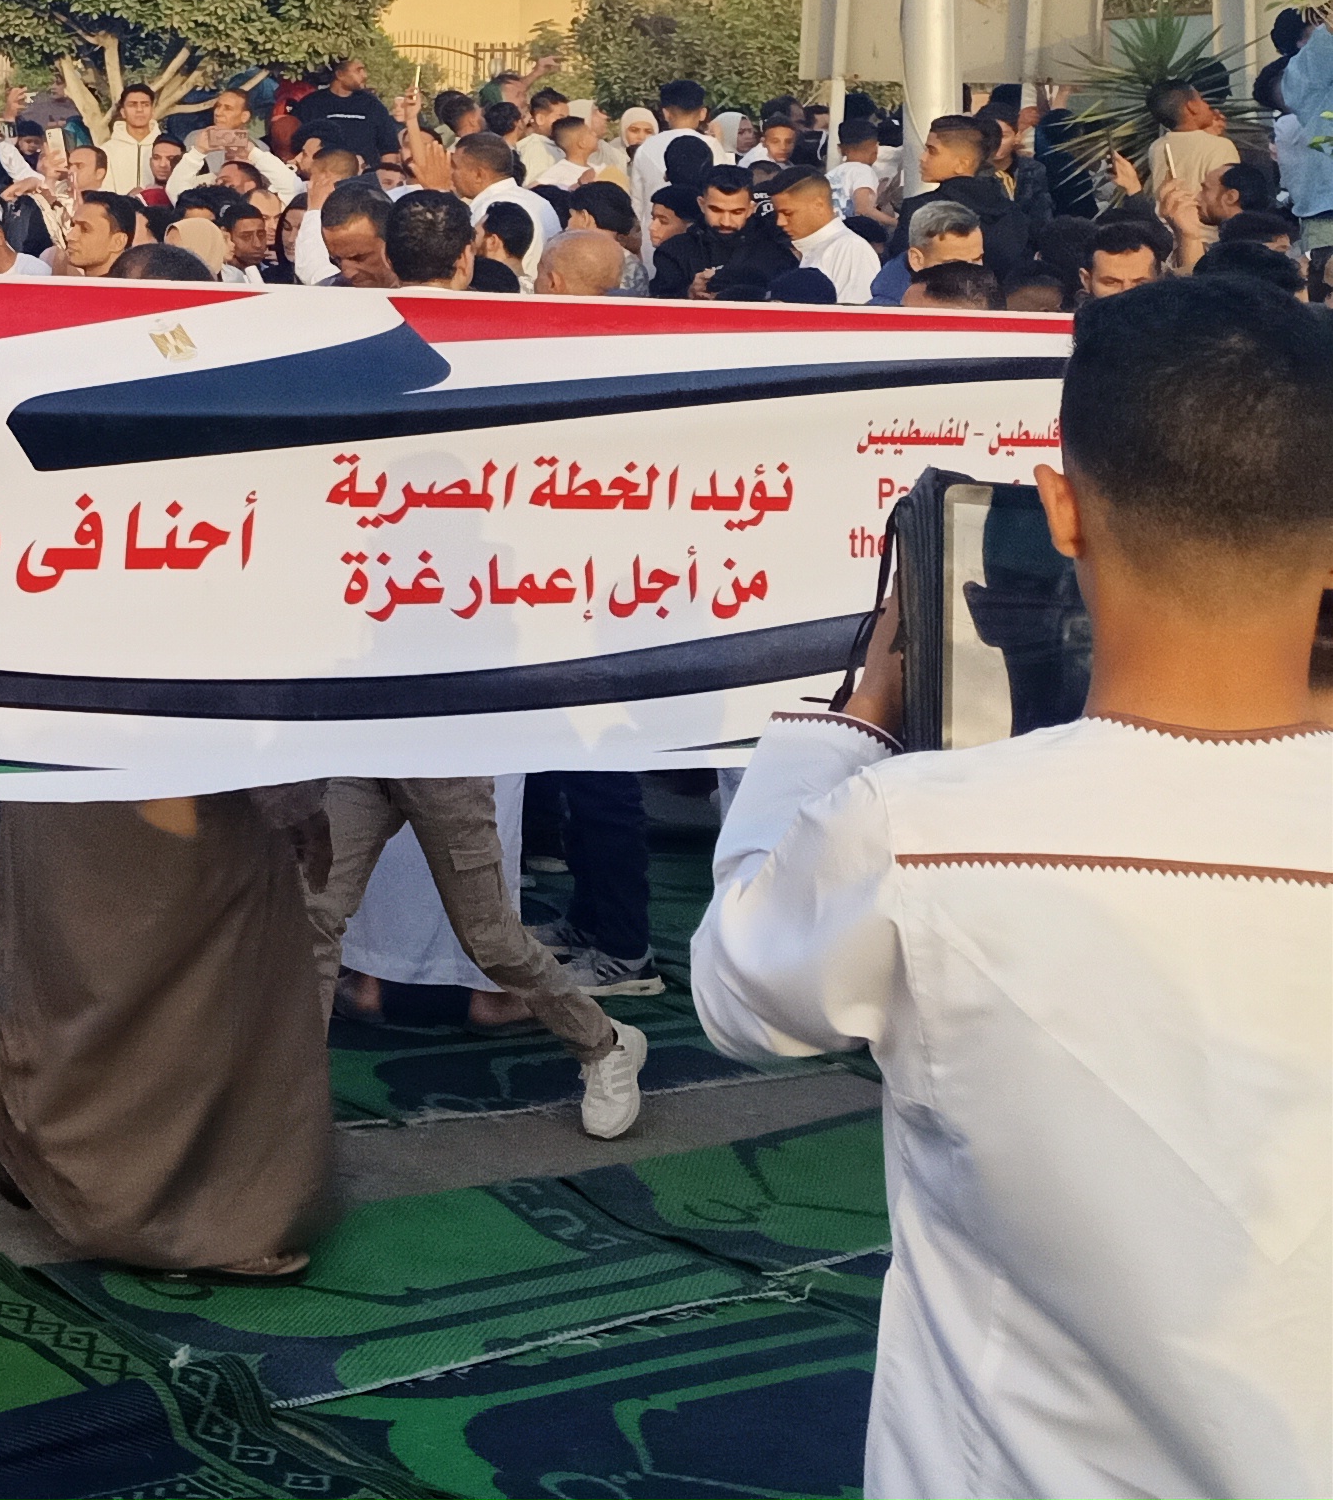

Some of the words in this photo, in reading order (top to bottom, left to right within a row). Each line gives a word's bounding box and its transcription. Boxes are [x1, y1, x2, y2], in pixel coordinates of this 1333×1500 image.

[324, 452, 519, 529] المصرية
[528, 455, 681, 513] الخطة
[689, 462, 796, 531] نؤيد
[123, 490, 258, 572] أحنا
[340, 549, 446, 622] غزة
[452, 555, 596, 624] إعمار
[608, 545, 699, 619] أجل
[710, 557, 770, 620] من
